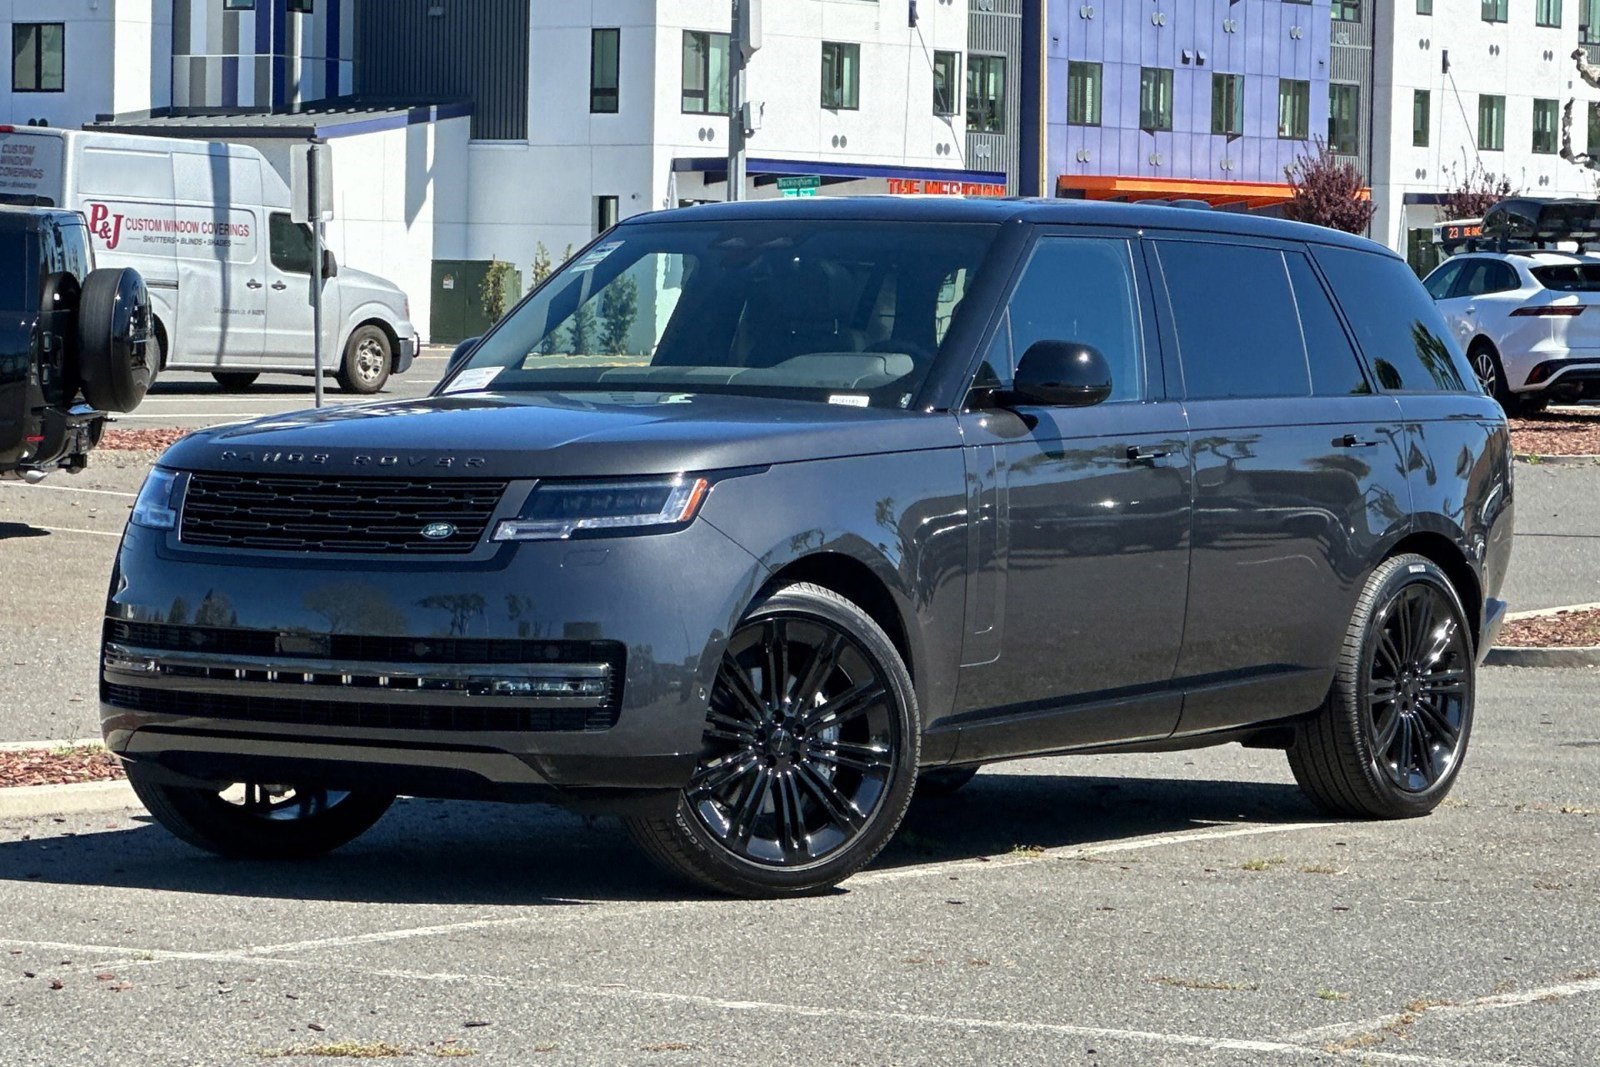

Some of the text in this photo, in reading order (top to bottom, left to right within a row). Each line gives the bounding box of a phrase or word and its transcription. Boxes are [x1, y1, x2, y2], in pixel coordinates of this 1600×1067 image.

[2, 143, 36, 155] CUSTOM
[0, 154, 34, 166] WINDOW
[0, 166, 45, 179] COVERINGS
[887, 178, 921, 195] THE
[89, 203, 124, 250] P&J
[125, 217, 249, 238] CUSTOM WINDOW COVERINGS
[1448, 226, 1459, 239] 23
[142, 235, 232, 248] SHUTTERS BLINDS SHADES
[220, 450, 486, 469] RANGE ROVER
